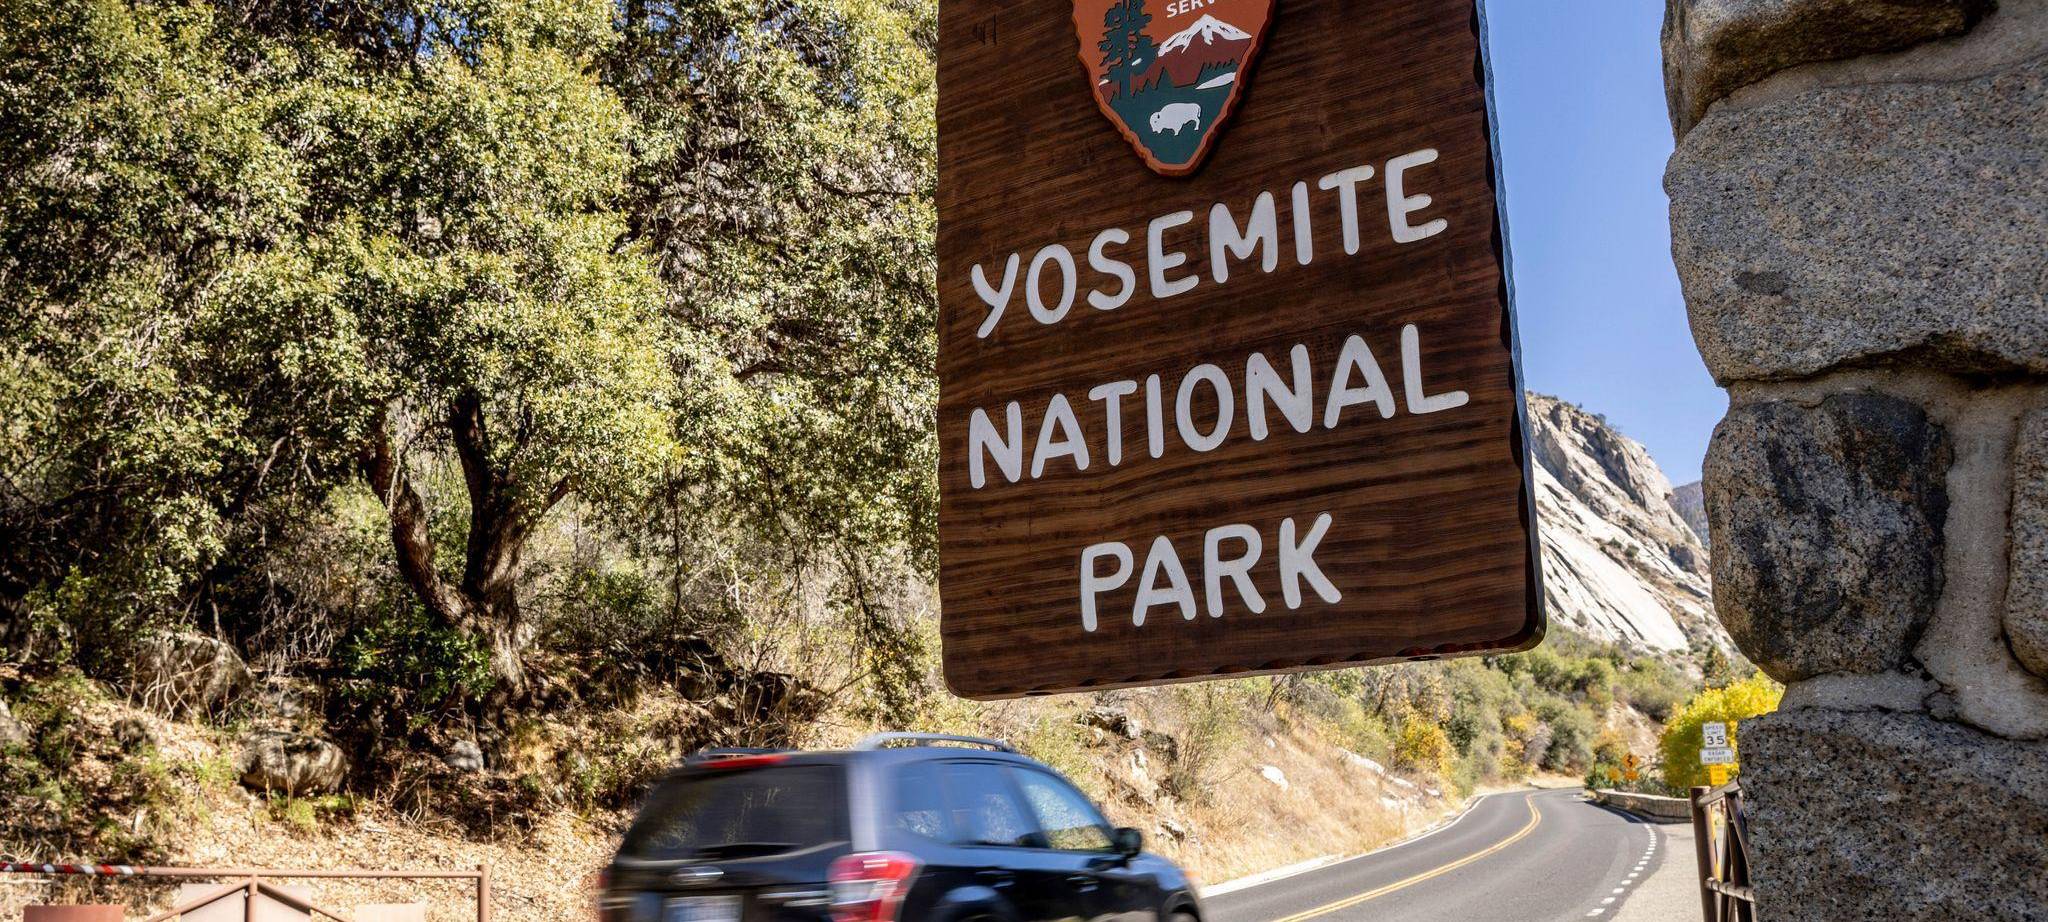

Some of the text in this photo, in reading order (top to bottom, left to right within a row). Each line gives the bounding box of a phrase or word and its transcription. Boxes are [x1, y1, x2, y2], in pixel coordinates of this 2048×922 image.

[1166, 0, 1215, 18] SER
[971, 148, 1448, 339] YOSEMITE
[968, 323, 1470, 489] NATIONAL
[1080, 512, 1343, 633] PARK
[1706, 735, 1725, 745] 35
